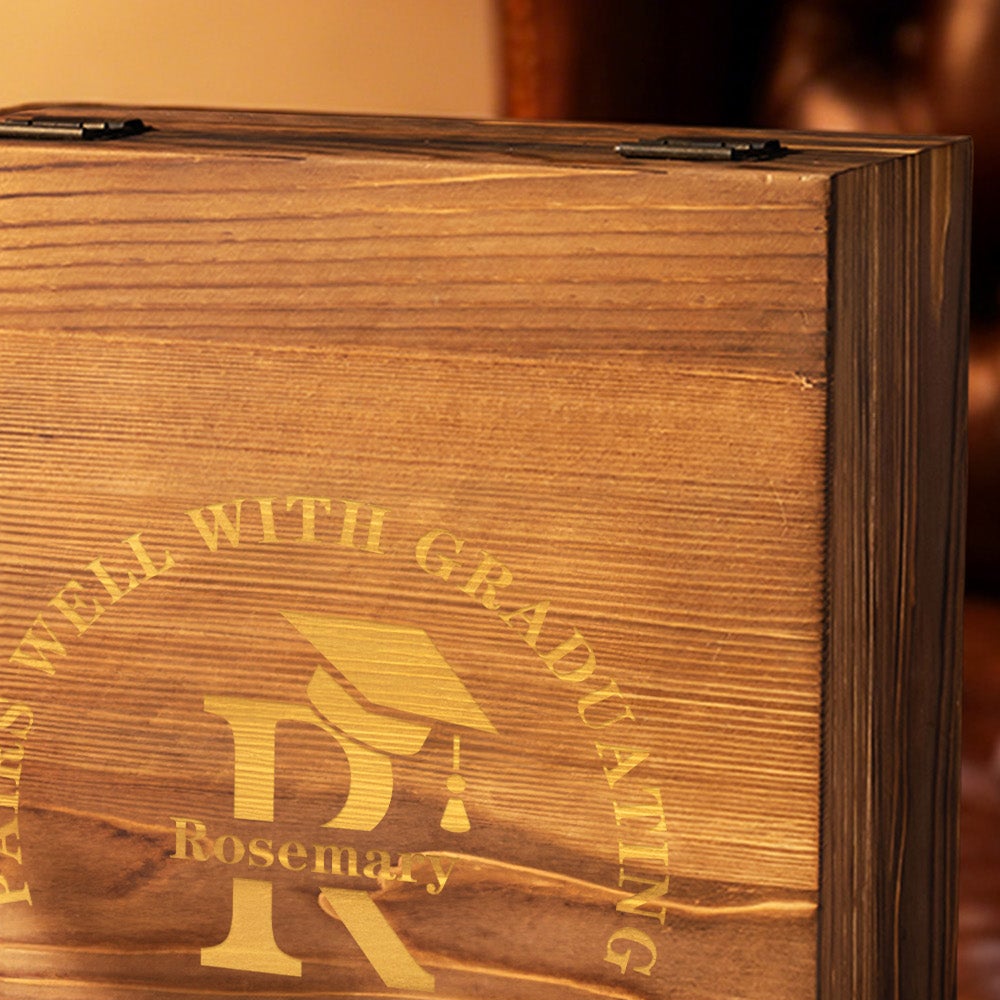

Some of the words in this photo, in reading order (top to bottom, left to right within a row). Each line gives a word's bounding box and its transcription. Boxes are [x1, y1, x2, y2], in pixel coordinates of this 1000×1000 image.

[9, 532, 176, 676] WELL
[187, 497, 388, 554] WITH
[415, 529, 669, 976] GRADUATING
[169, 817, 459, 895] Rosemary
